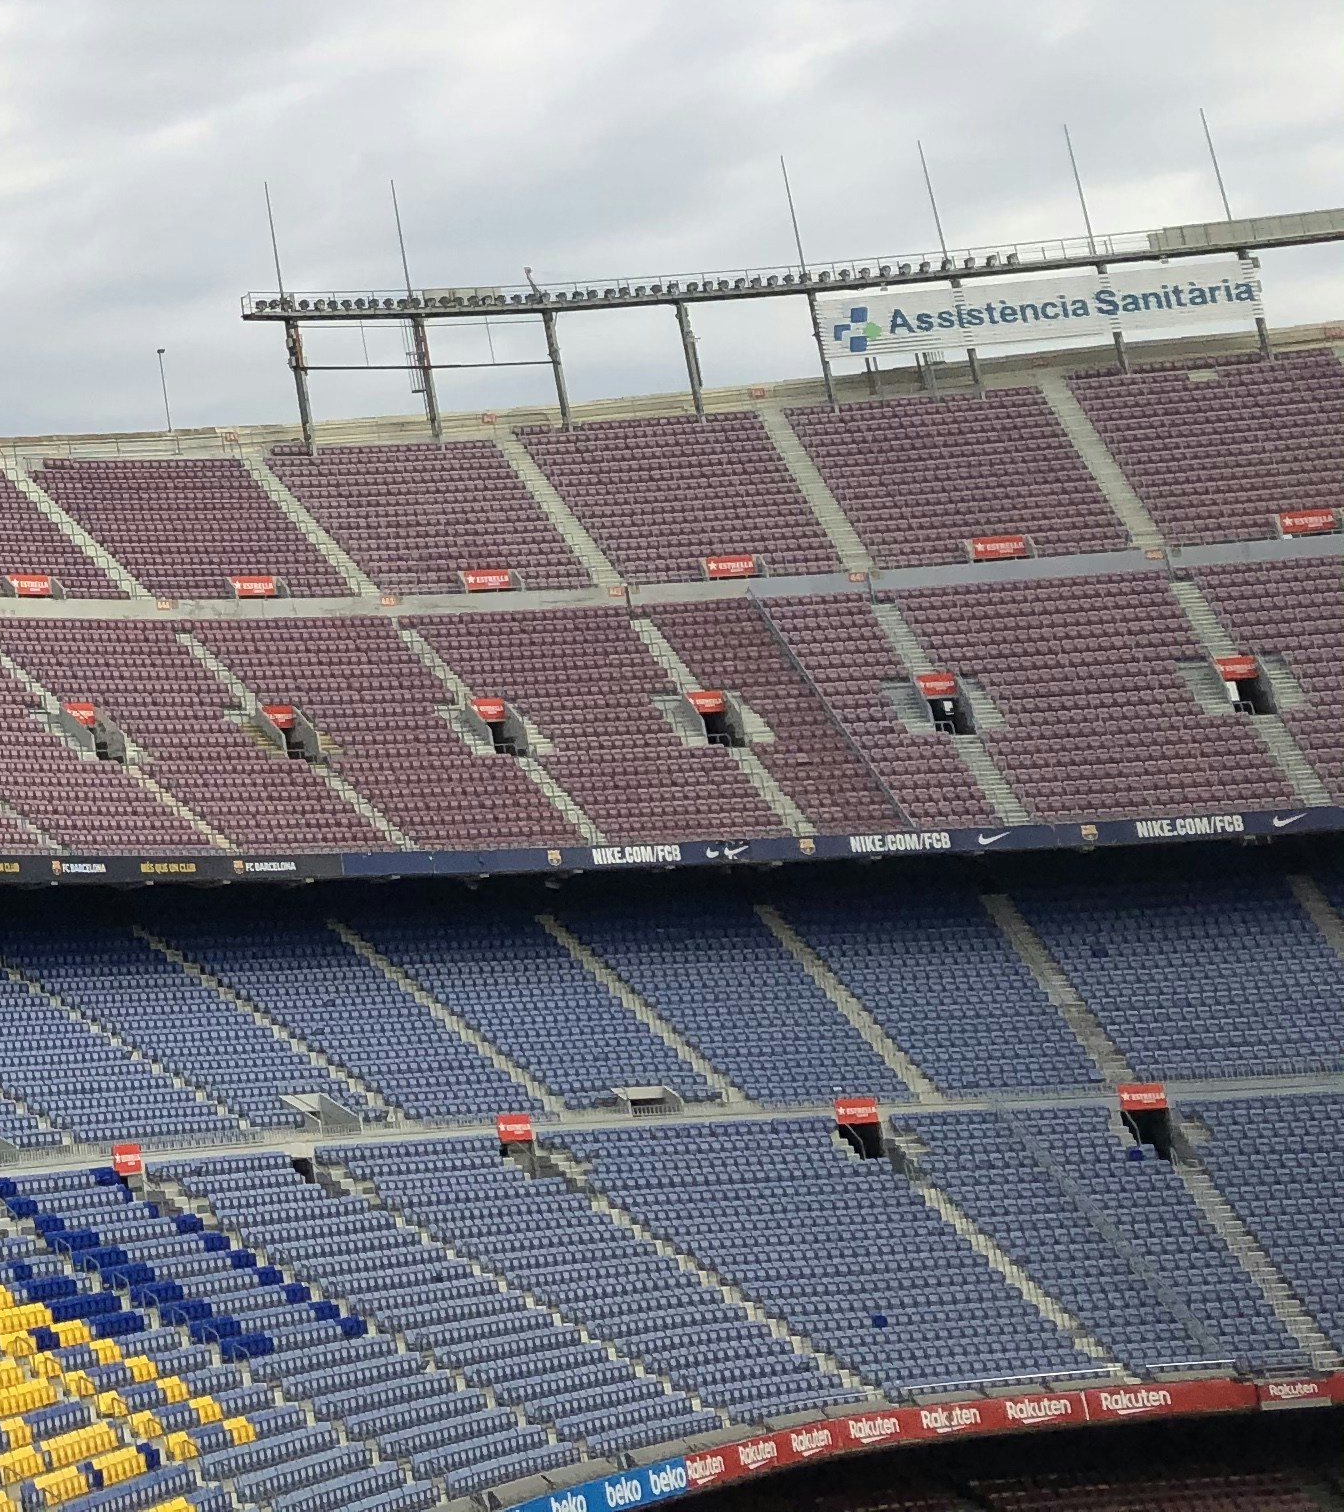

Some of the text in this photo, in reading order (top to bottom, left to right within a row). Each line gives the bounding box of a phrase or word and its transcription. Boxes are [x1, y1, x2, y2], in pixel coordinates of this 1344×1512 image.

[890, 279, 1257, 334] Assistència Sanitària
[1136, 815, 1245, 838] NIKE.COM/FCB
[592, 844, 682, 865] NIKE.COM/FCB
[1100, 1387, 1171, 1410] Rakuten
[1269, 1382, 1318, 1397] Rakuten
[1006, 1398, 1071, 1421] Rakuten
[848, 1416, 900, 1439] Rakuten
[791, 1428, 832, 1452] Rakuten
[738, 1440, 777, 1467] Rakuten
[686, 1455, 725, 1481] Rakuten
[648, 1465, 687, 1496] beko
[604, 1477, 642, 1508] beko
